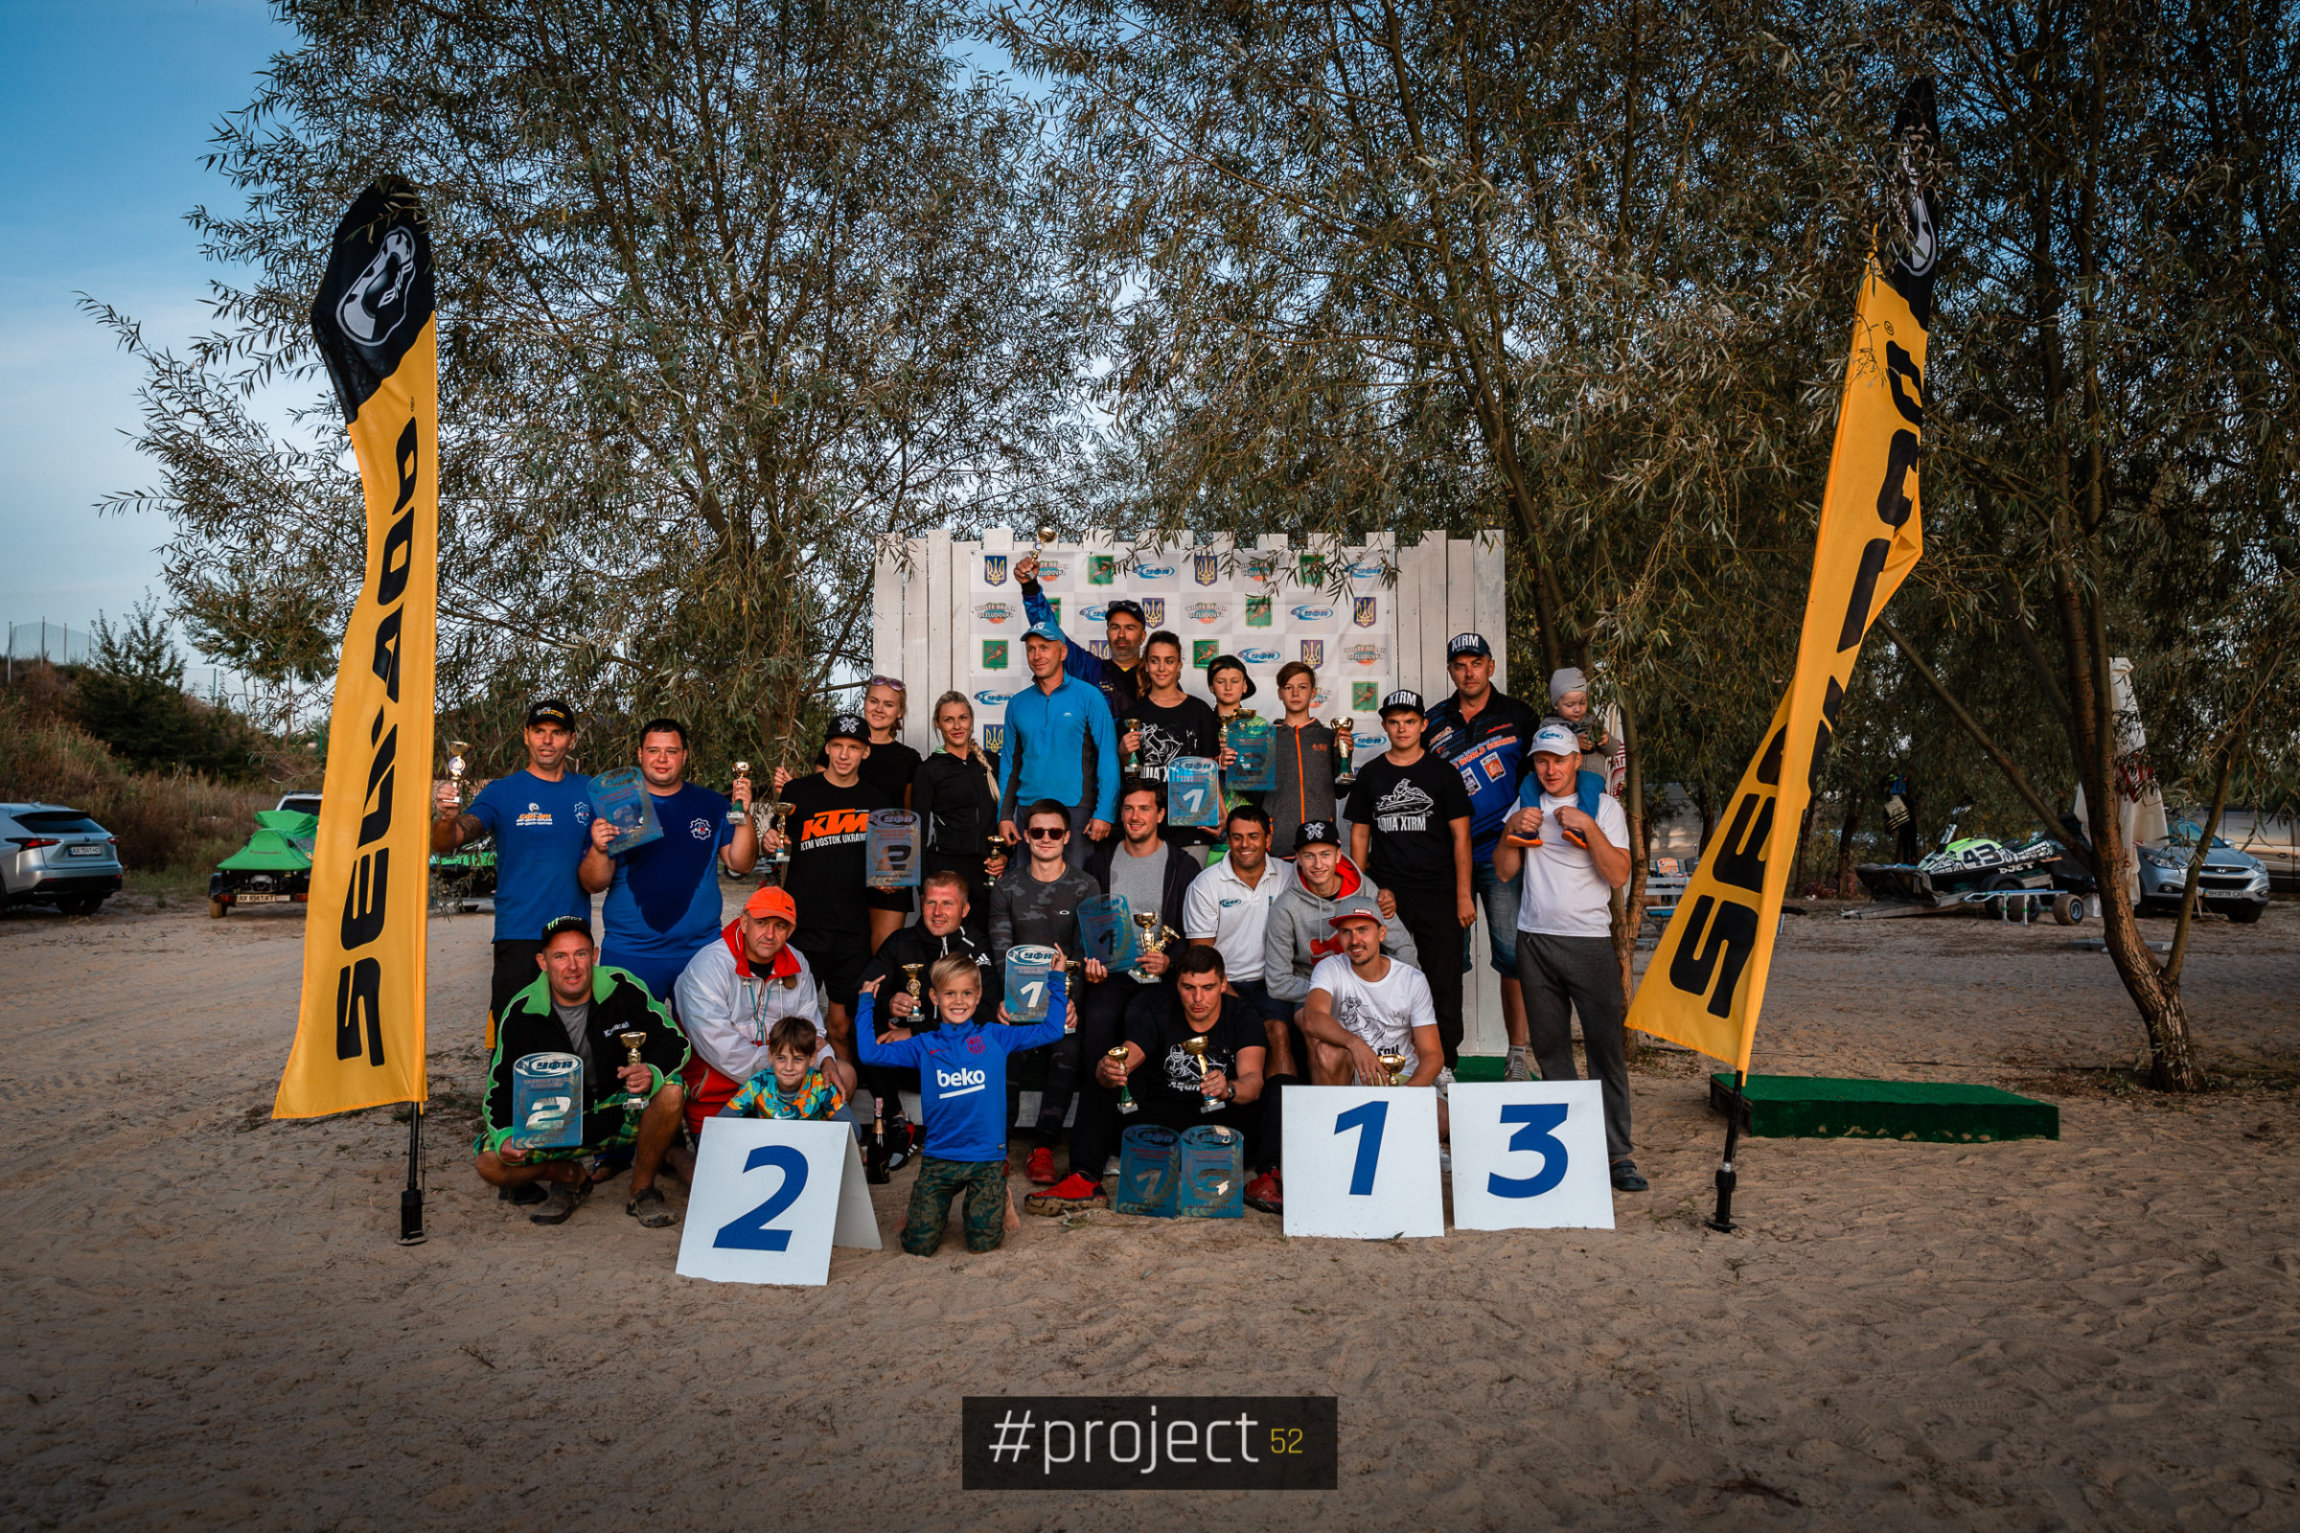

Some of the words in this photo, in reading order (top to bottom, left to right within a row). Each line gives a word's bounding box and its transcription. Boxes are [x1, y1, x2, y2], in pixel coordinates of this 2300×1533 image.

[1452, 634, 1480, 652] XTRM
[1388, 691, 1417, 706] XTRM
[1183, 788, 1205, 813] 1
[801, 808, 869, 842] KTM
[1400, 812, 1426, 832] XTRM
[801, 839, 814, 851] KTM
[1963, 843, 2000, 867] 43
[1020, 981, 1045, 1008] 1
[936, 1067, 986, 1088] beko
[525, 1096, 571, 1130] 2
[1333, 1100, 1389, 1196] 1
[1487, 1103, 1569, 1199] 3
[712, 1144, 809, 1252] 2
